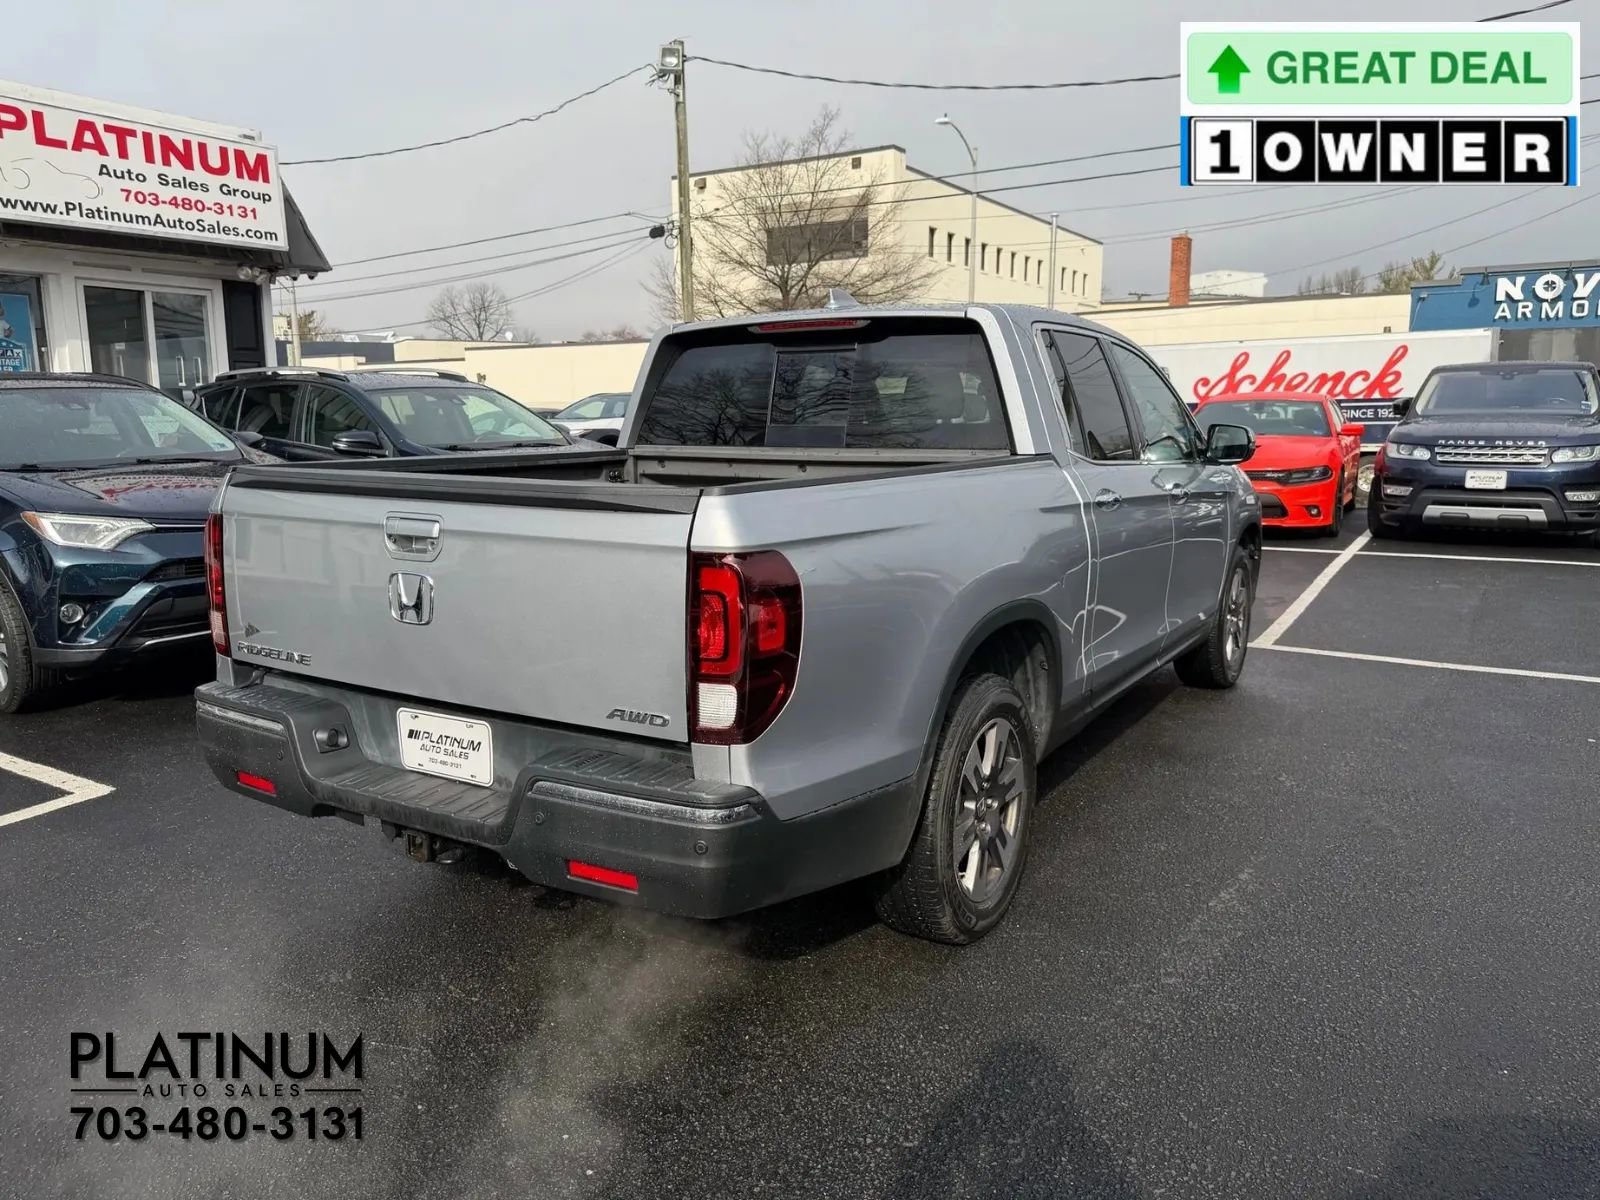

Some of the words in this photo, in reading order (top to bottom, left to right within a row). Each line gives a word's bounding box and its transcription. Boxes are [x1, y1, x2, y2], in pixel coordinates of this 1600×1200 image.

[0, 103, 271, 184] PLATINUM
[98, 163, 147, 184] Auto
[158, 173, 210, 194] Sales
[219, 183, 272, 204] Group
[120, 188, 258, 221] 703-480-3131
[0, 198, 279, 242] www.PlatinumAutoSales.com
[1494, 299, 1600, 319] ARMO
[1193, 344, 1409, 399] Schenck
[1341, 408, 1375, 418] SINCE
[237, 640, 312, 666] RIDGELINE
[606, 707, 671, 727] AWD
[420, 743, 441, 754] AUTO
[443, 748, 469, 760] SALES
[421, 730, 482, 752] PLATINUM
